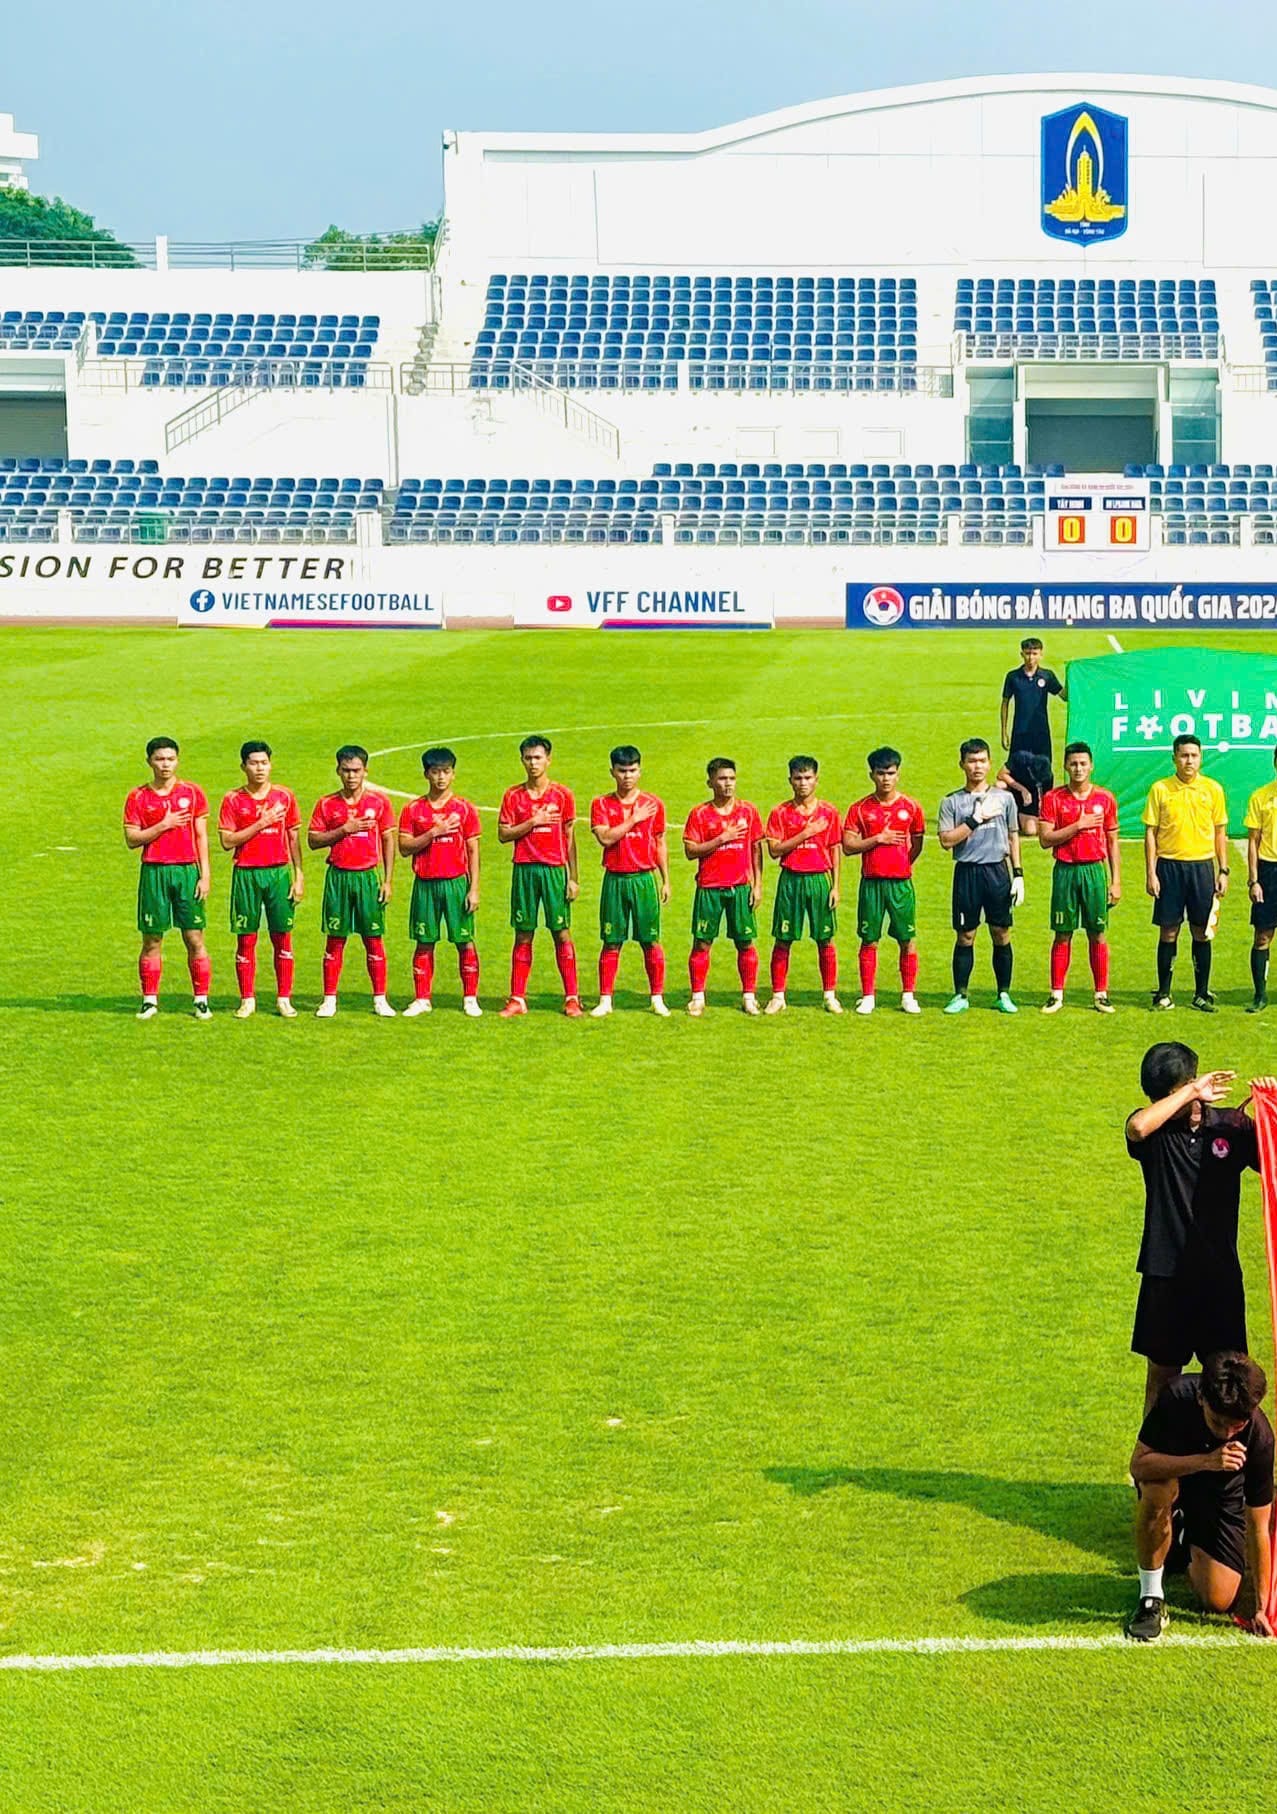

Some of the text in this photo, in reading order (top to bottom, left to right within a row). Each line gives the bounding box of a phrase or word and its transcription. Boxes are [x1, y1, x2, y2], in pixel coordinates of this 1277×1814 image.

[1062, 517, 1080, 542] 0
[1115, 517, 1132, 542] 0
[108, 556, 185, 579] FOR
[202, 557, 344, 580] BETTER
[222, 592, 434, 612] VIETNAMESEFOOTBALL
[586, 591, 745, 613] VFF CHANNEL
[909, 587, 952, 620] GIẢI
[955, 588, 1012, 620] BÓNG
[1014, 588, 1045, 620] ĐÁ
[1048, 594, 1105, 626] HẠNG
[1109, 594, 1138, 620] BA
[1140, 584, 1194, 623] QUỐC
[1197, 594, 1234, 620] GIA
[145, 913, 153, 927] 4
[236, 914, 248, 928] 21
[328, 916, 340, 930] 22
[959, 912, 965, 926] 1
[1055, 911, 1064, 925] 11
[781, 919, 789, 933] 6
[861, 920, 869, 933] 2
